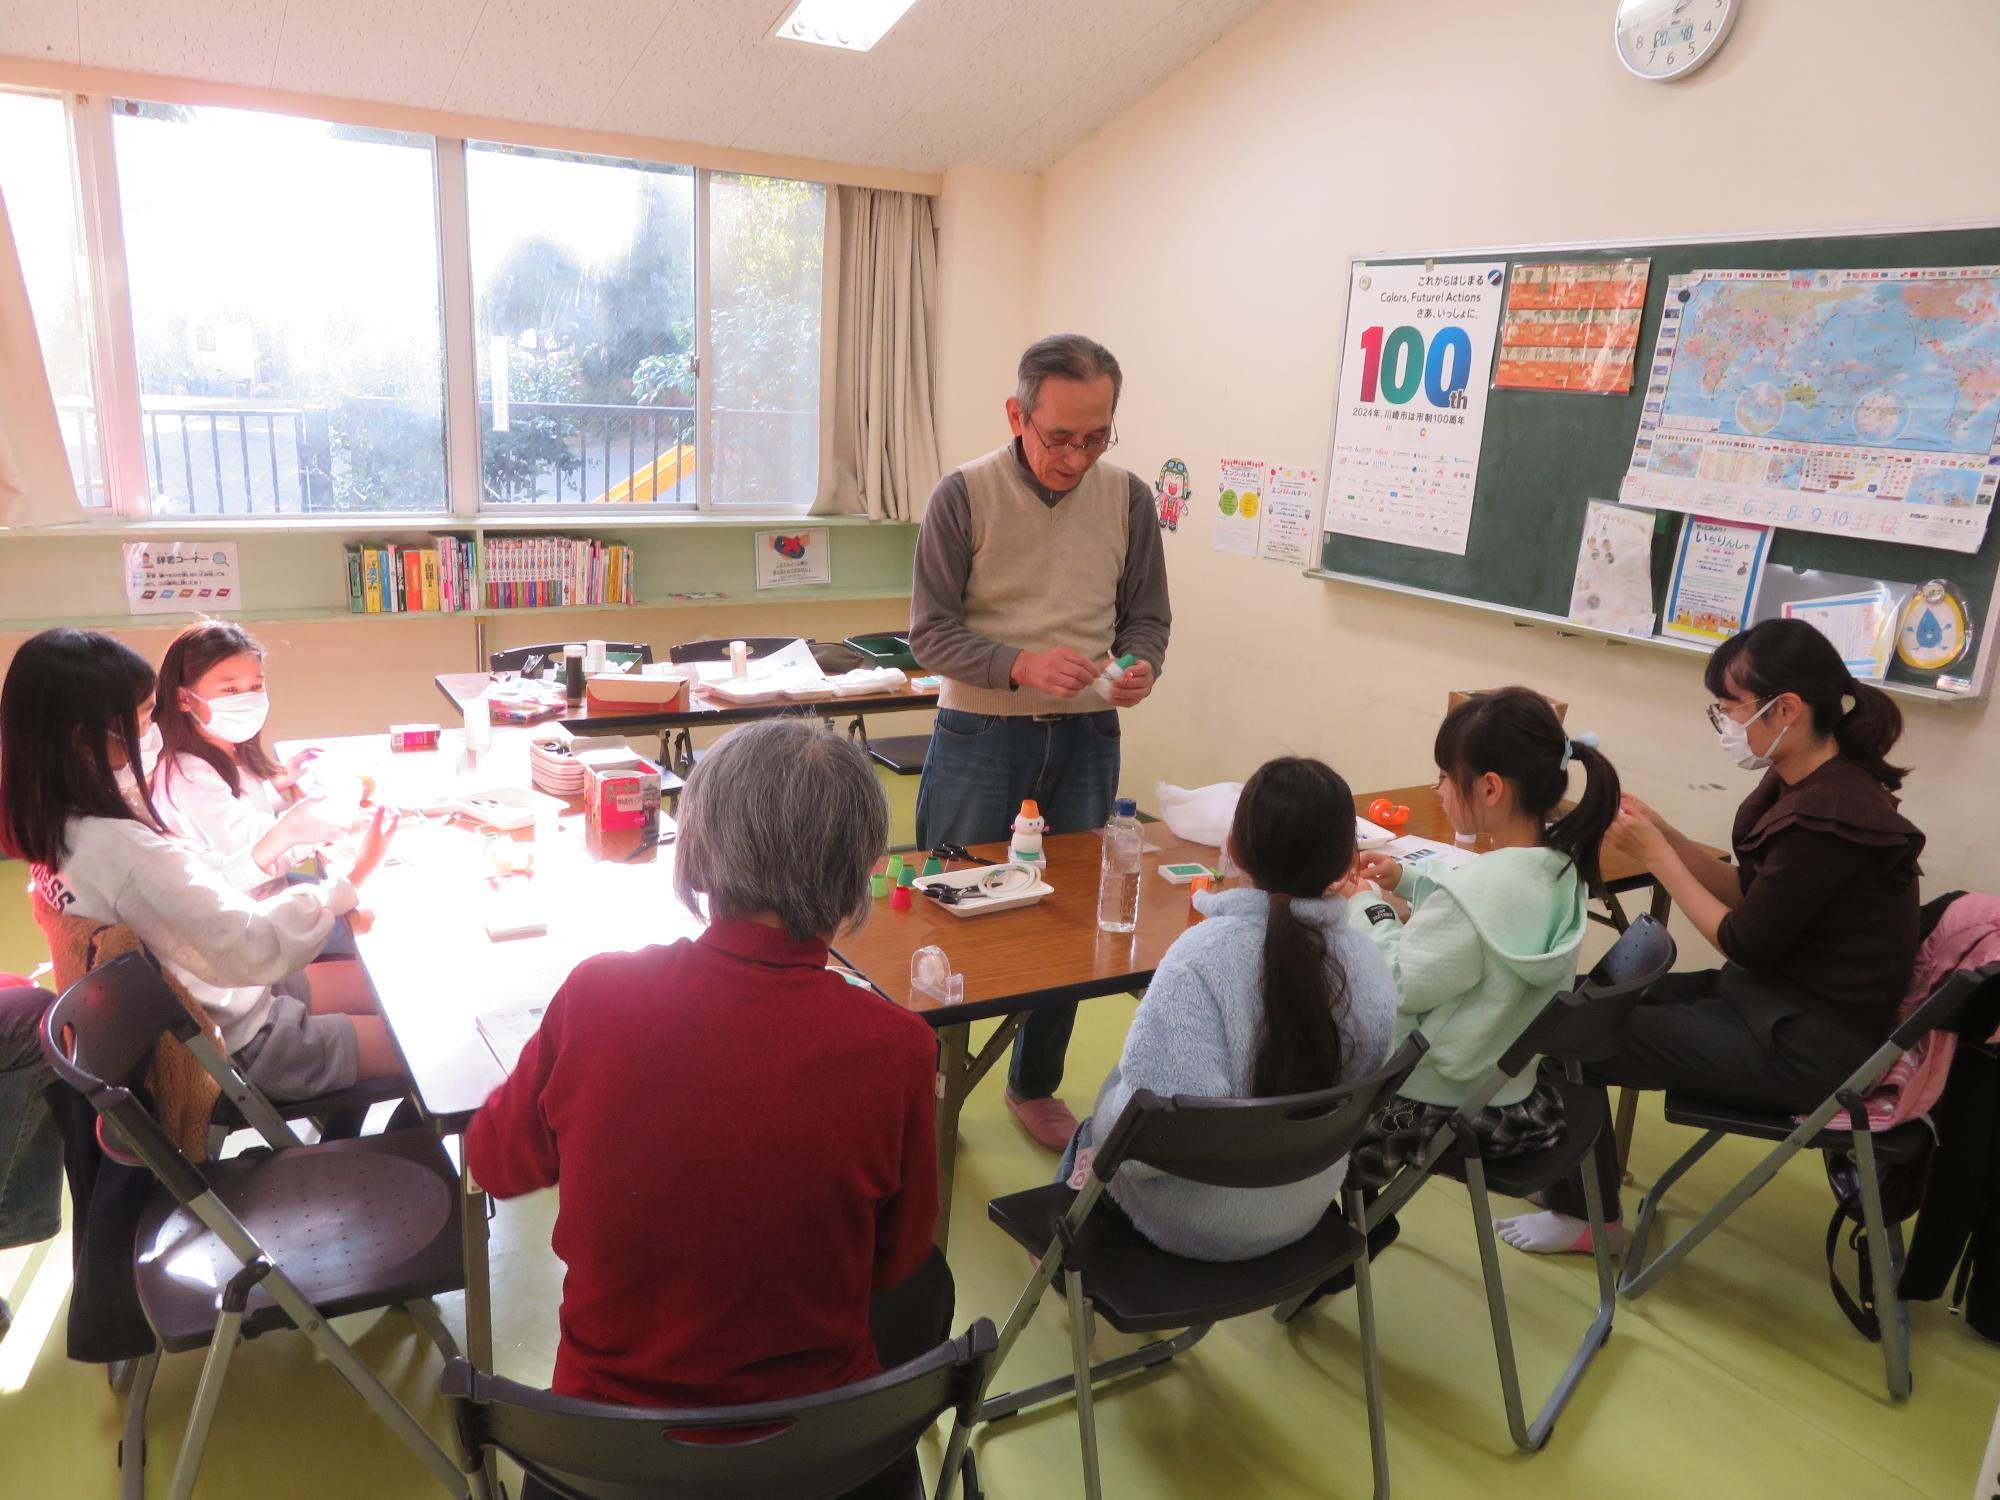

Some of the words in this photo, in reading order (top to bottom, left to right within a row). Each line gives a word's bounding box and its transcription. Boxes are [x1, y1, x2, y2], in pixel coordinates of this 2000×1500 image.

[1704, 20, 1712, 33] 4
[1636, 36, 1644, 49] 8
[1688, 41, 1695, 56] 5
[1649, 50, 1656, 65] 7
[1667, 51, 1675, 65] 6
[1418, 275, 1484, 286] これからはじまる
[1380, 292, 1410, 304] Colors,
[1411, 292, 1444, 302] Future!
[1446, 292, 1481, 303] Actions
[1695, 530, 1751, 551] いちりんしゃ
